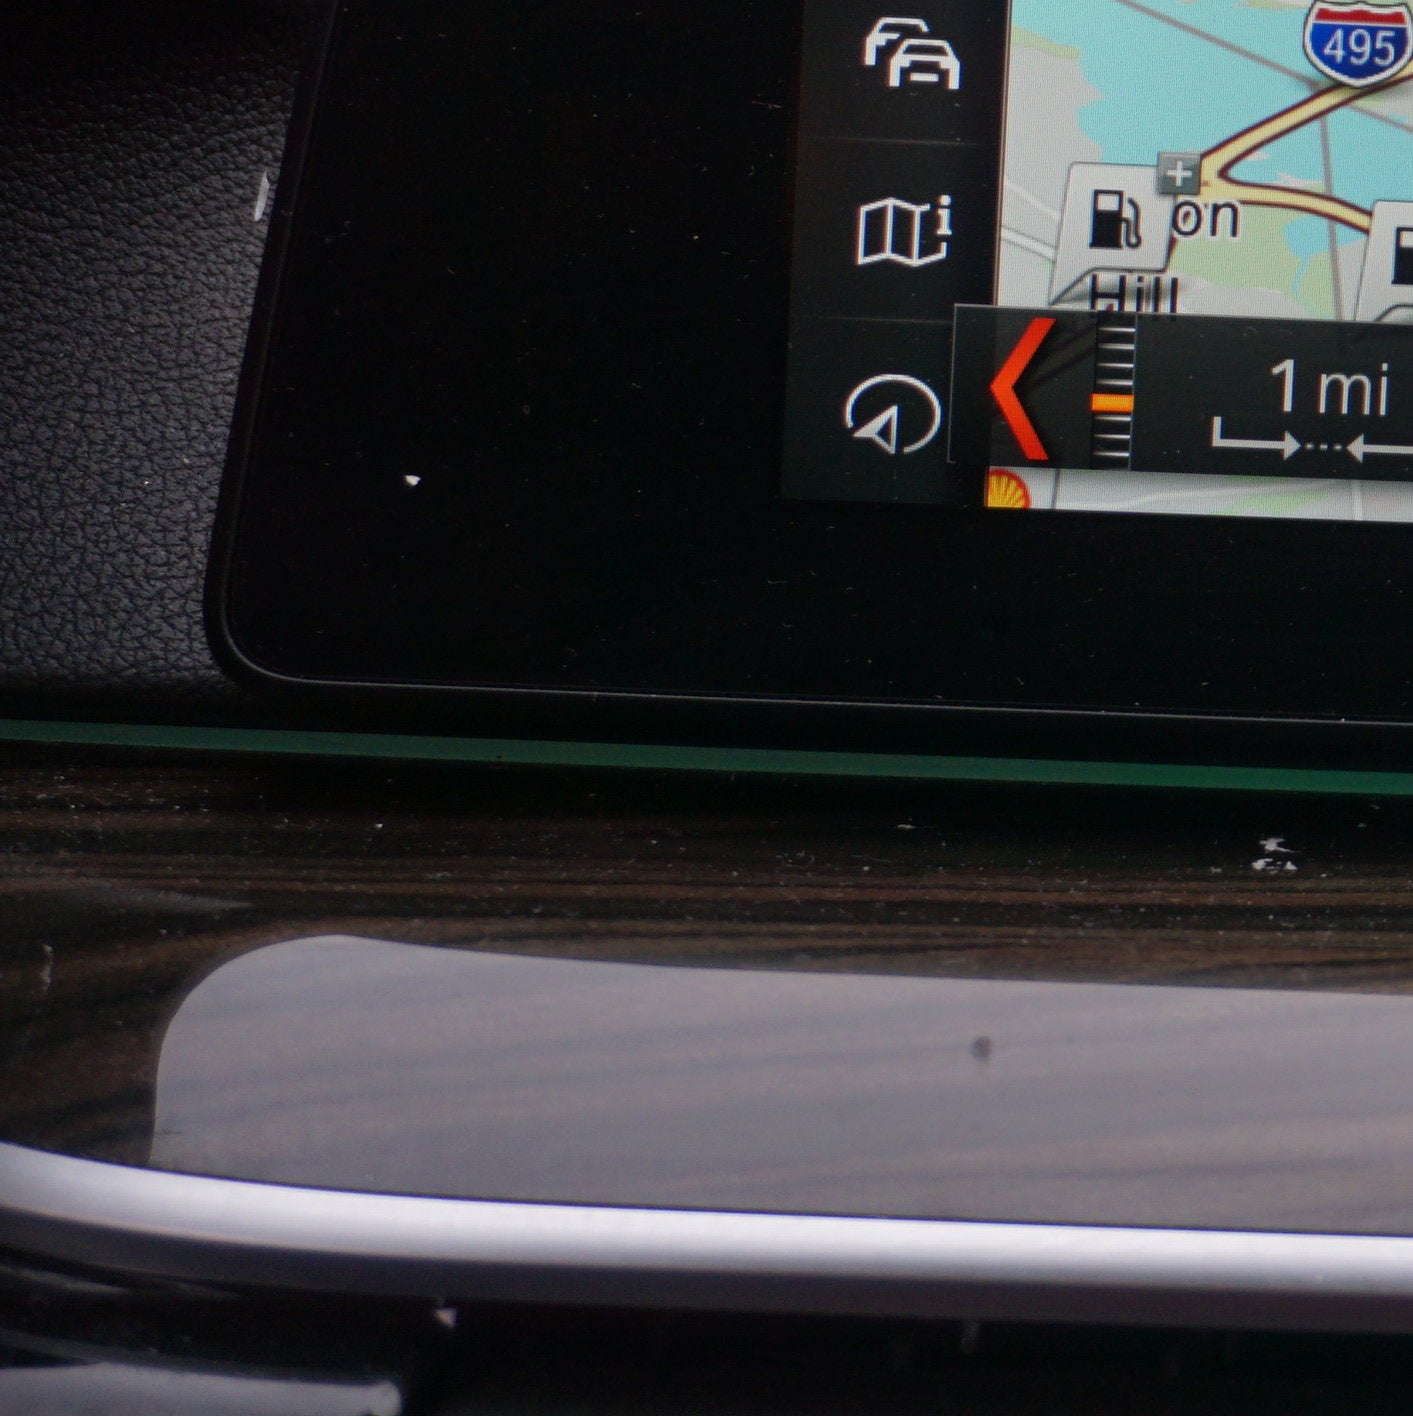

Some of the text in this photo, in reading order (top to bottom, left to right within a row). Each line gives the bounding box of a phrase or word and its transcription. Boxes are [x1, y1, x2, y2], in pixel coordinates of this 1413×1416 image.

[1323, 29, 1396, 68] 495
[1090, 273, 1178, 316] Hill
[1270, 360, 1390, 417] 1 mi
